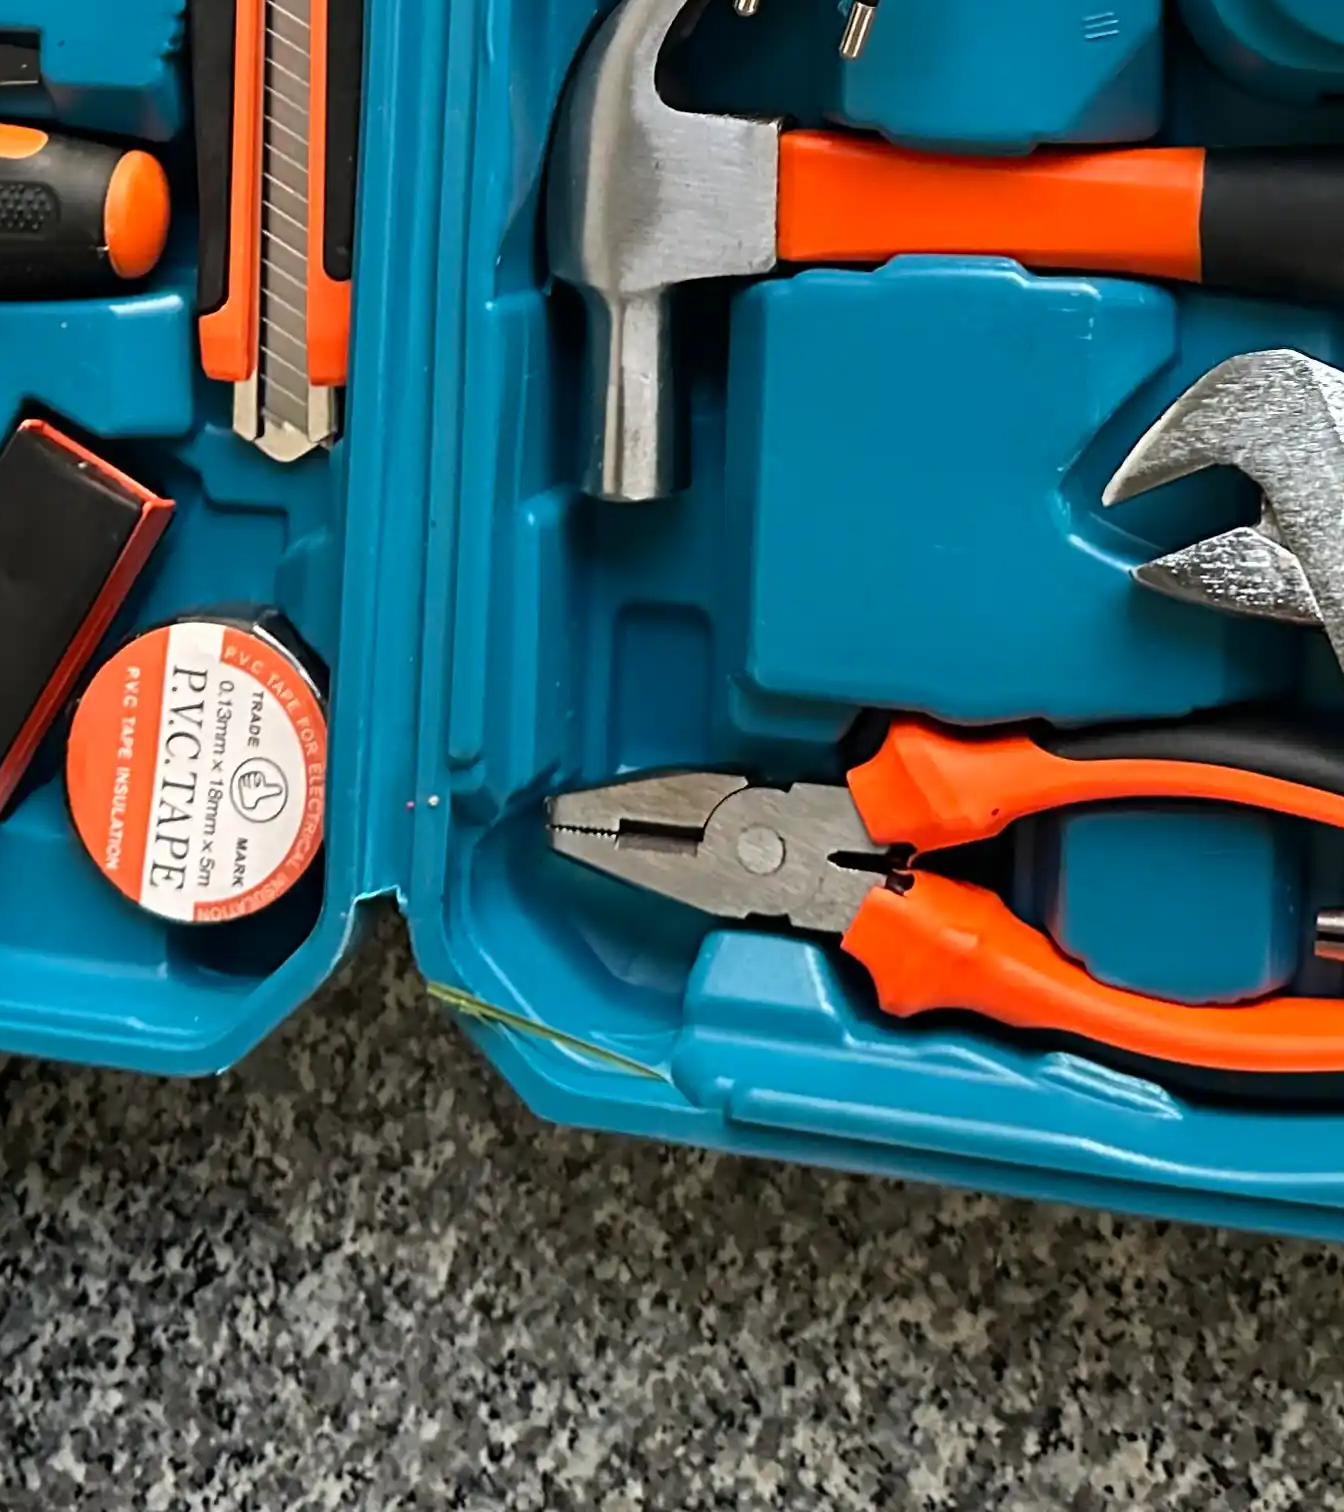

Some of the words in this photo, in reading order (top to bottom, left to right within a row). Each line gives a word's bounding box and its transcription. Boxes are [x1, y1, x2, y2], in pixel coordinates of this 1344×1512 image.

[212, 679, 235, 755] 0.13mm
[267, 671, 302, 712] TAPE
[118, 717, 136, 760] TAPE
[247, 691, 264, 748] TRADE
[296, 716, 320, 756] FOR
[105, 767, 131, 870] INSULATION
[203, 778, 224, 836] 18mm
[284, 762, 323, 869] ELECTRICAL
[197, 856, 216, 887] 5m
[232, 837, 248, 888] MARK
